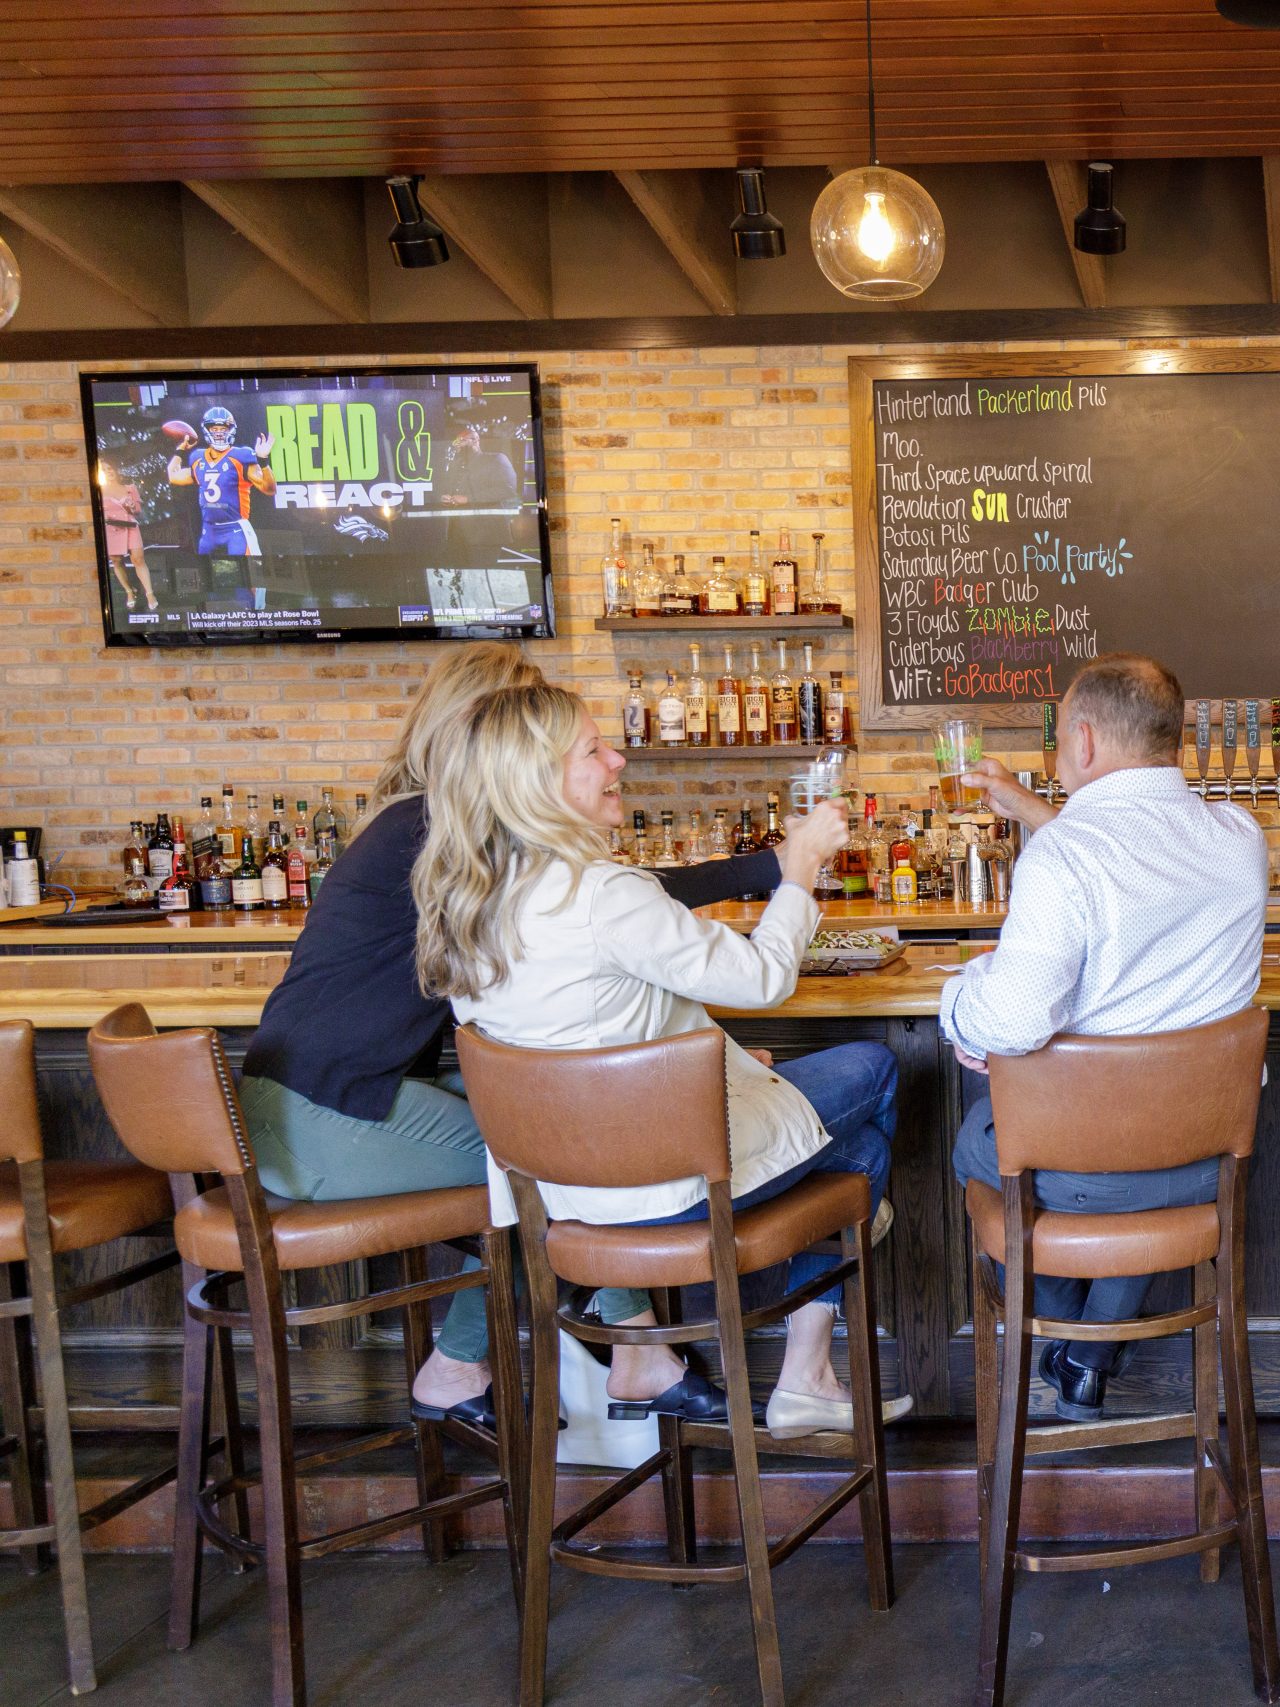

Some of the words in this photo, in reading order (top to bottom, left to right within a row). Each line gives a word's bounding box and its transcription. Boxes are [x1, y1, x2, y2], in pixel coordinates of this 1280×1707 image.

[491, 374, 512, 383] LIVE
[877, 382, 972, 424] Hinterland
[978, 380, 1073, 416] Packerland
[266, 403, 379, 482] READ
[397, 401, 433, 482] &
[883, 432, 924, 459] Moo.
[203, 472, 222, 503] 3
[877, 461, 922, 492] Third
[925, 463, 970, 490] Space
[275, 482, 433, 509] REACT
[882, 494, 966, 524] Revolution
[1016, 491, 1071, 519] Crusher
[883, 524, 935, 550] Potosi
[882, 550, 948, 582] Saturday
[952, 547, 988, 575] Beer
[993, 548, 1020, 573] Co.
[1023, 538, 1060, 573] Pool
[1066, 543, 1119, 577] Party
[883, 579, 927, 608] WBC
[934, 577, 995, 608] Badger
[1002, 573, 1039, 603] Club
[128, 614, 160, 624] ESPN
[191, 612, 201, 620] LA
[201, 611, 246, 621] Galaxy-LAFC
[248, 611, 256, 619] to
[257, 611, 274, 621] play
[274, 611, 282, 619] at
[282, 610, 300, 619] Rose
[301, 610, 320, 618] Bowl
[192, 620, 204, 628] Will
[204, 620, 217, 628] kick
[217, 619, 227, 628] off
[227, 620, 241, 628] their
[242, 620, 258, 628] 2023
[259, 619, 273, 627] MLS
[300, 618, 313, 627] Feb.
[313, 618, 322, 626] 25
[887, 611, 902, 635] 3
[906, 607, 960, 641] Floyds
[1055, 603, 1091, 631] Dust
[889, 639, 966, 672] Ciderboys
[970, 635, 1059, 667] Blackberry
[1062, 629, 1099, 659] Wild
[944, 663, 1062, 698] GoBadgers1
